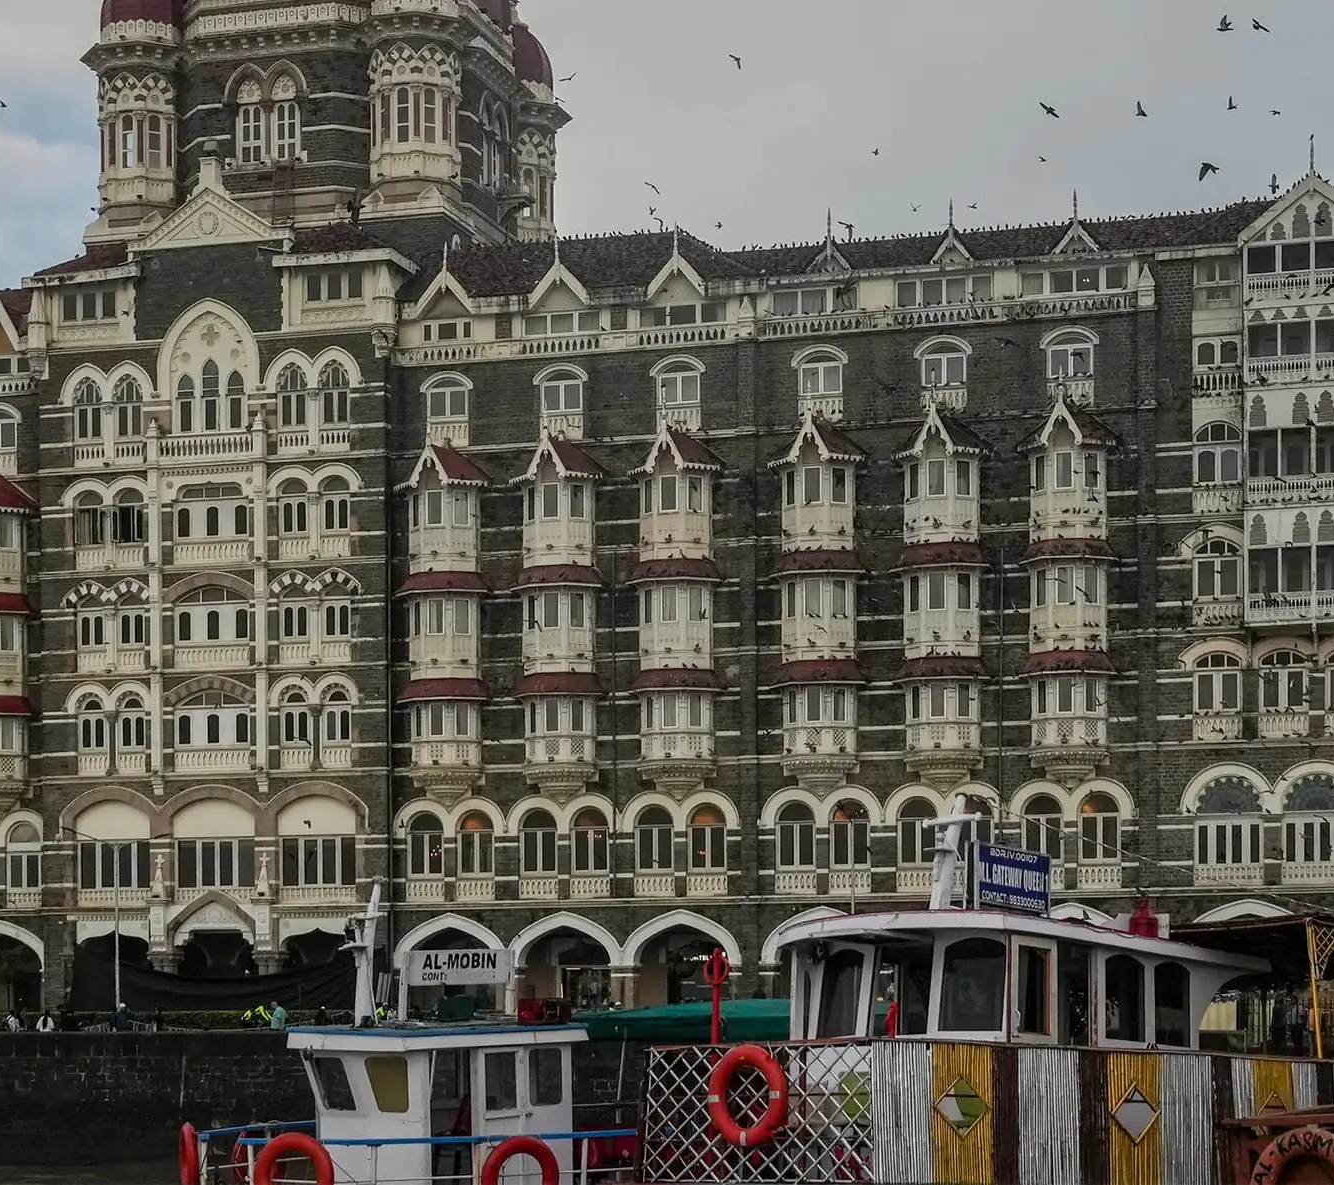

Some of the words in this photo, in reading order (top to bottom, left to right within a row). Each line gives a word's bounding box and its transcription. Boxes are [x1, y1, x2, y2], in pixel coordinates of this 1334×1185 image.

[992, 863, 1023, 889] GATEWAY
[1023, 869, 1045, 893] QUEEN
[422, 952, 497, 970] AL-MOBIN
[421, 971, 448, 981] CONT:
